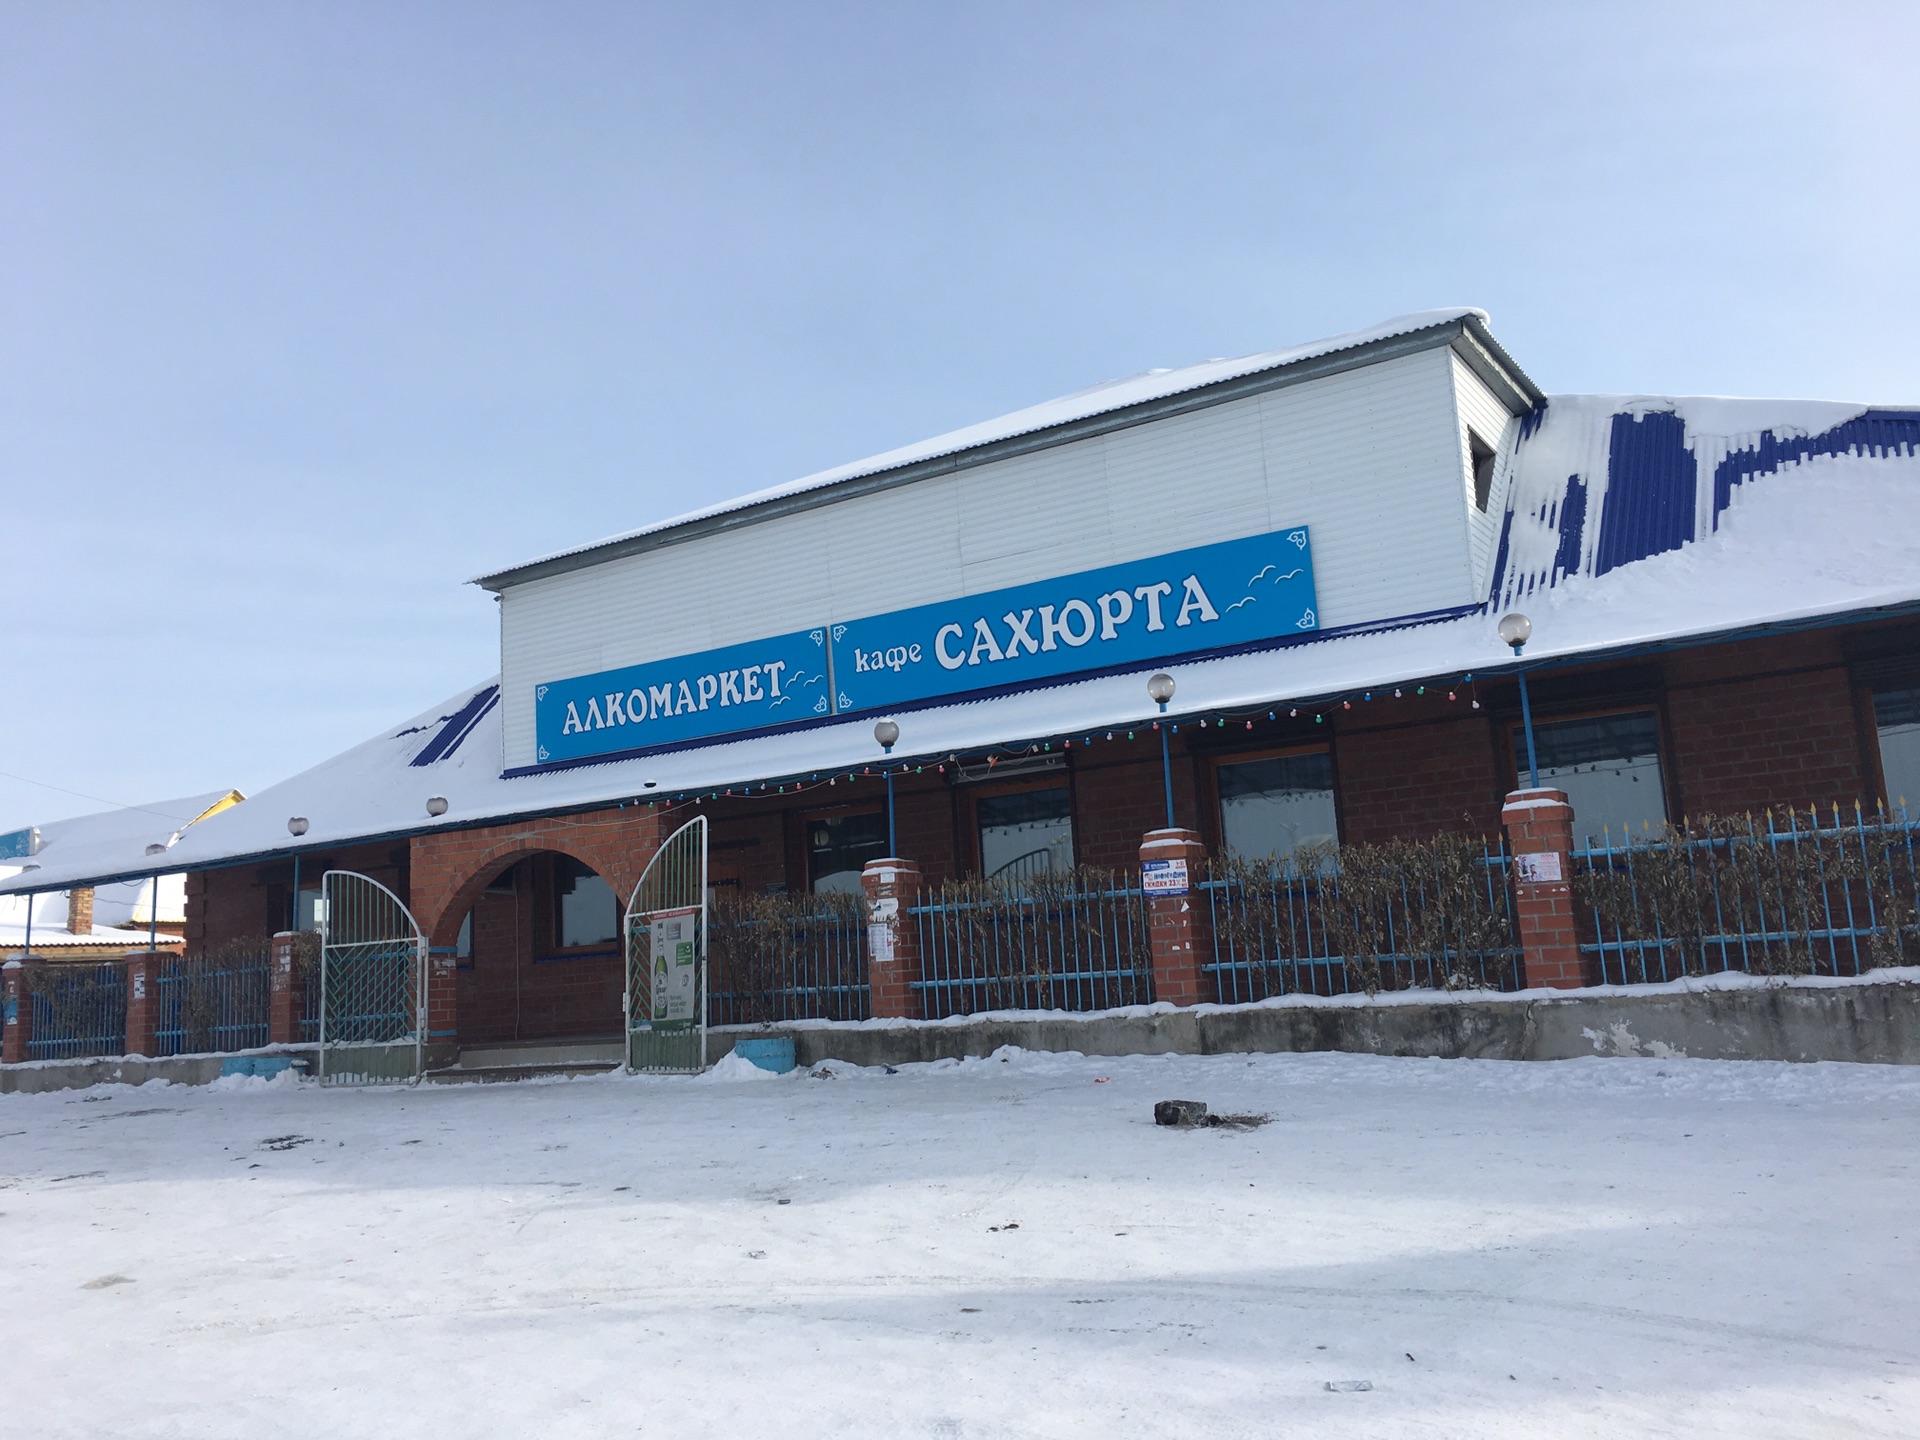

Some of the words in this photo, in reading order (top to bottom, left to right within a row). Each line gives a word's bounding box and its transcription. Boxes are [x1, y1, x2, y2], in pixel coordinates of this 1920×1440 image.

[853, 642, 922, 673] кафе
[934, 574, 1219, 670] САХЮРТА
[562, 660, 786, 735] АЛКОМАРКЕТ
